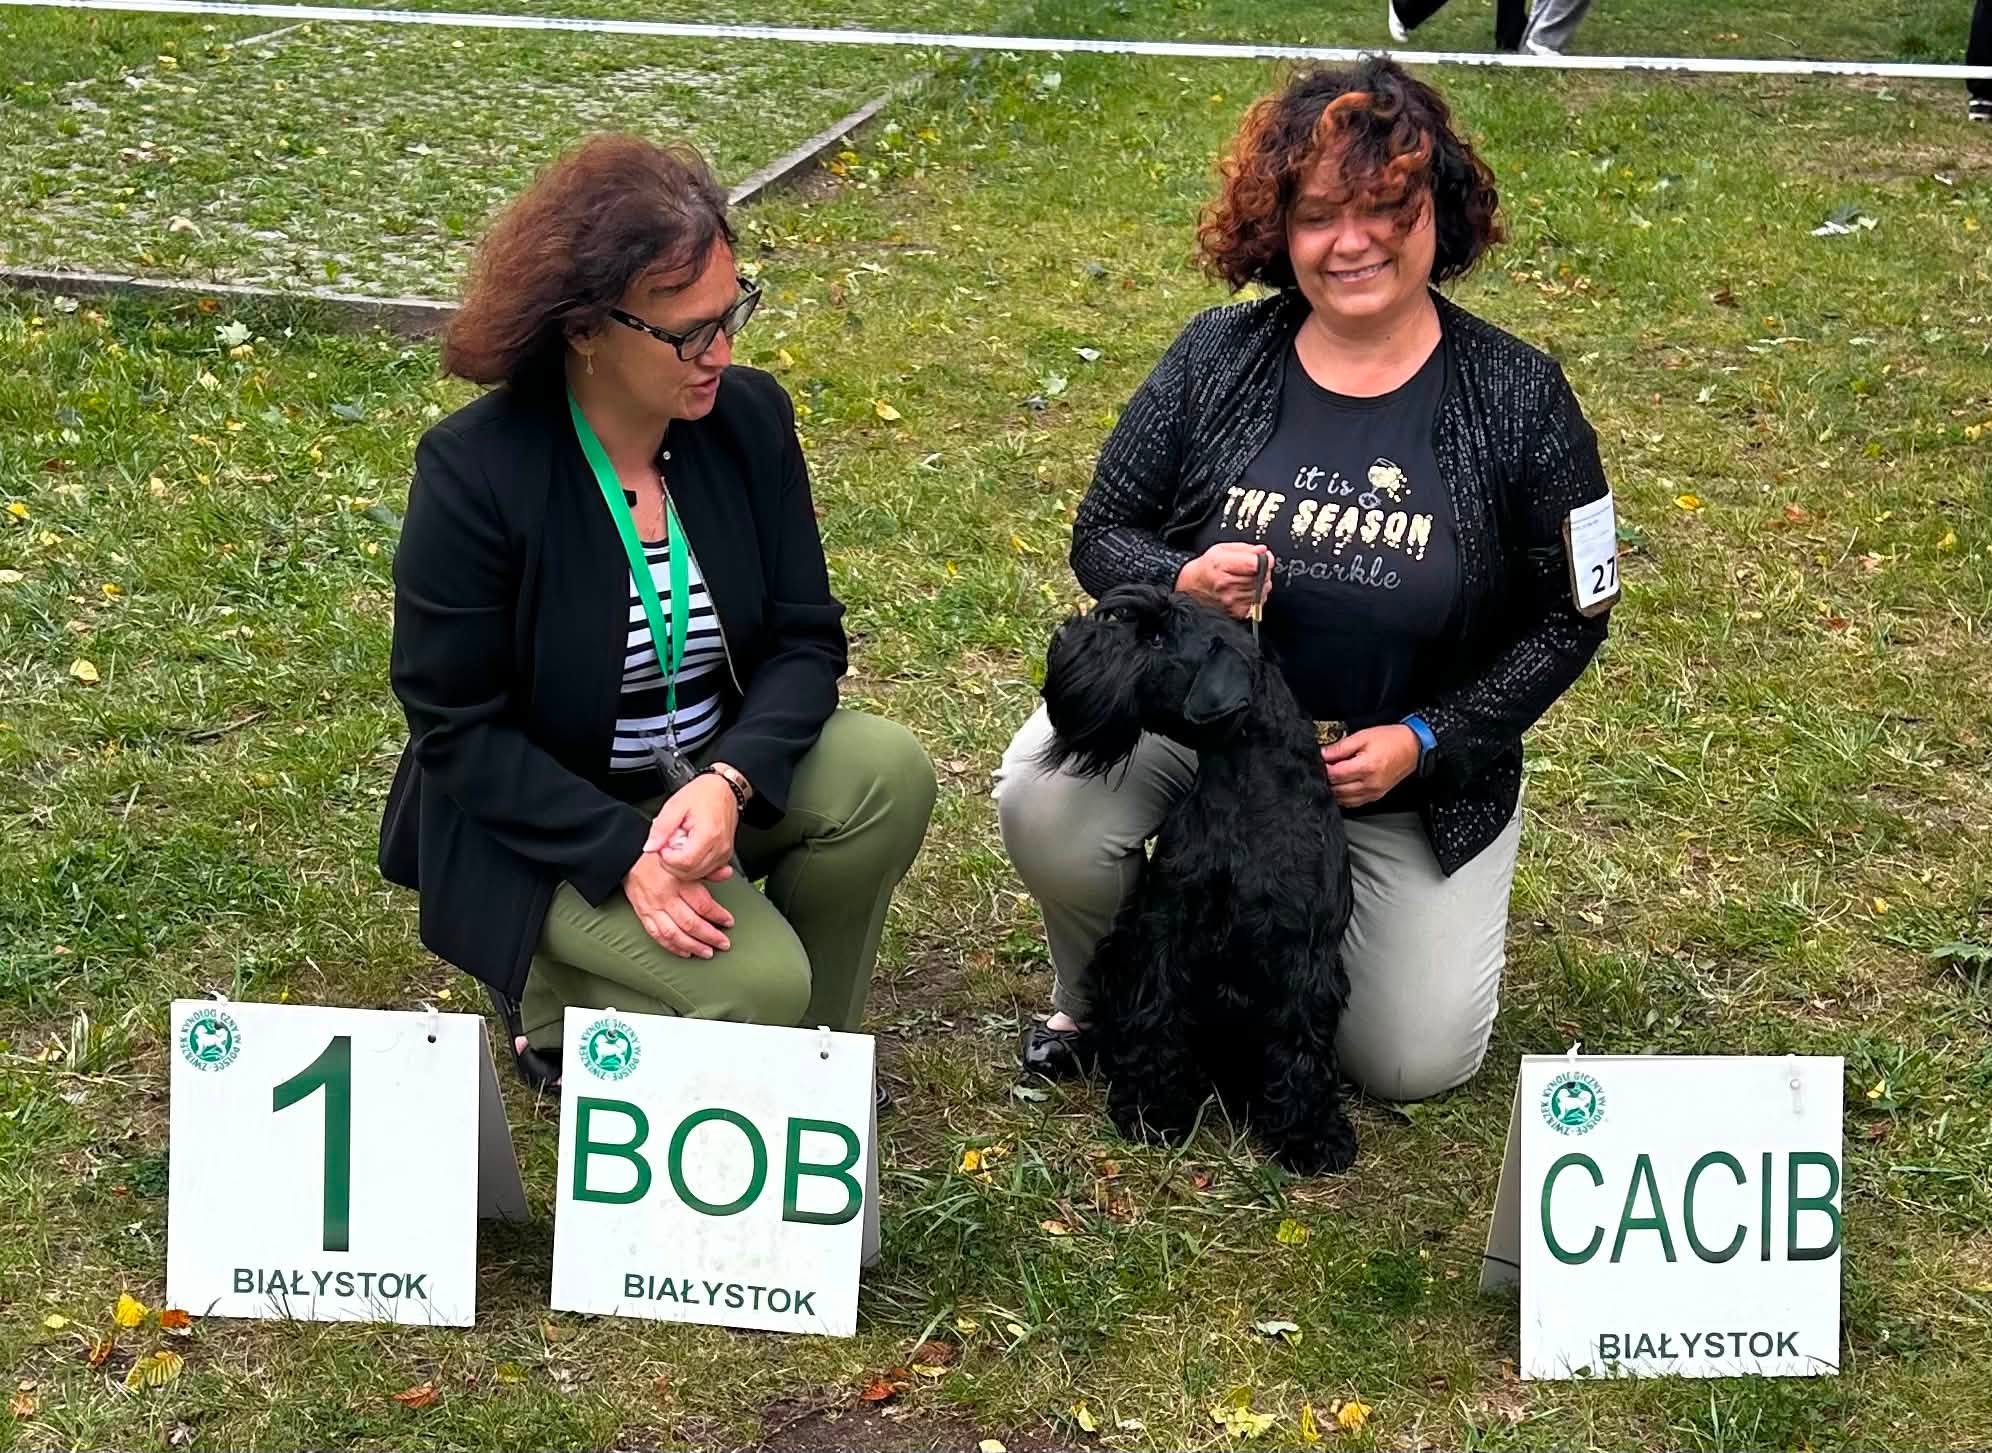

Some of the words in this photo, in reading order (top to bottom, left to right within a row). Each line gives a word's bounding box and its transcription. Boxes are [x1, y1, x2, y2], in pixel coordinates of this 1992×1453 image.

[1294, 466, 1325, 491] it
[1327, 472, 1355, 496] is
[1220, 485, 1286, 532] THE
[1291, 499, 1433, 556] SEASON
[1274, 554, 1401, 589] sparkle
[272, 1035, 352, 1252] 1
[573, 1096, 863, 1226] BOB
[1540, 1150, 1841, 1265] CACIB
[233, 1267, 428, 1299] BIAŁYSTOK
[624, 1273, 817, 1316] BIAŁYSTOK
[1599, 1331, 1801, 1360] BIAŁYSTOK
